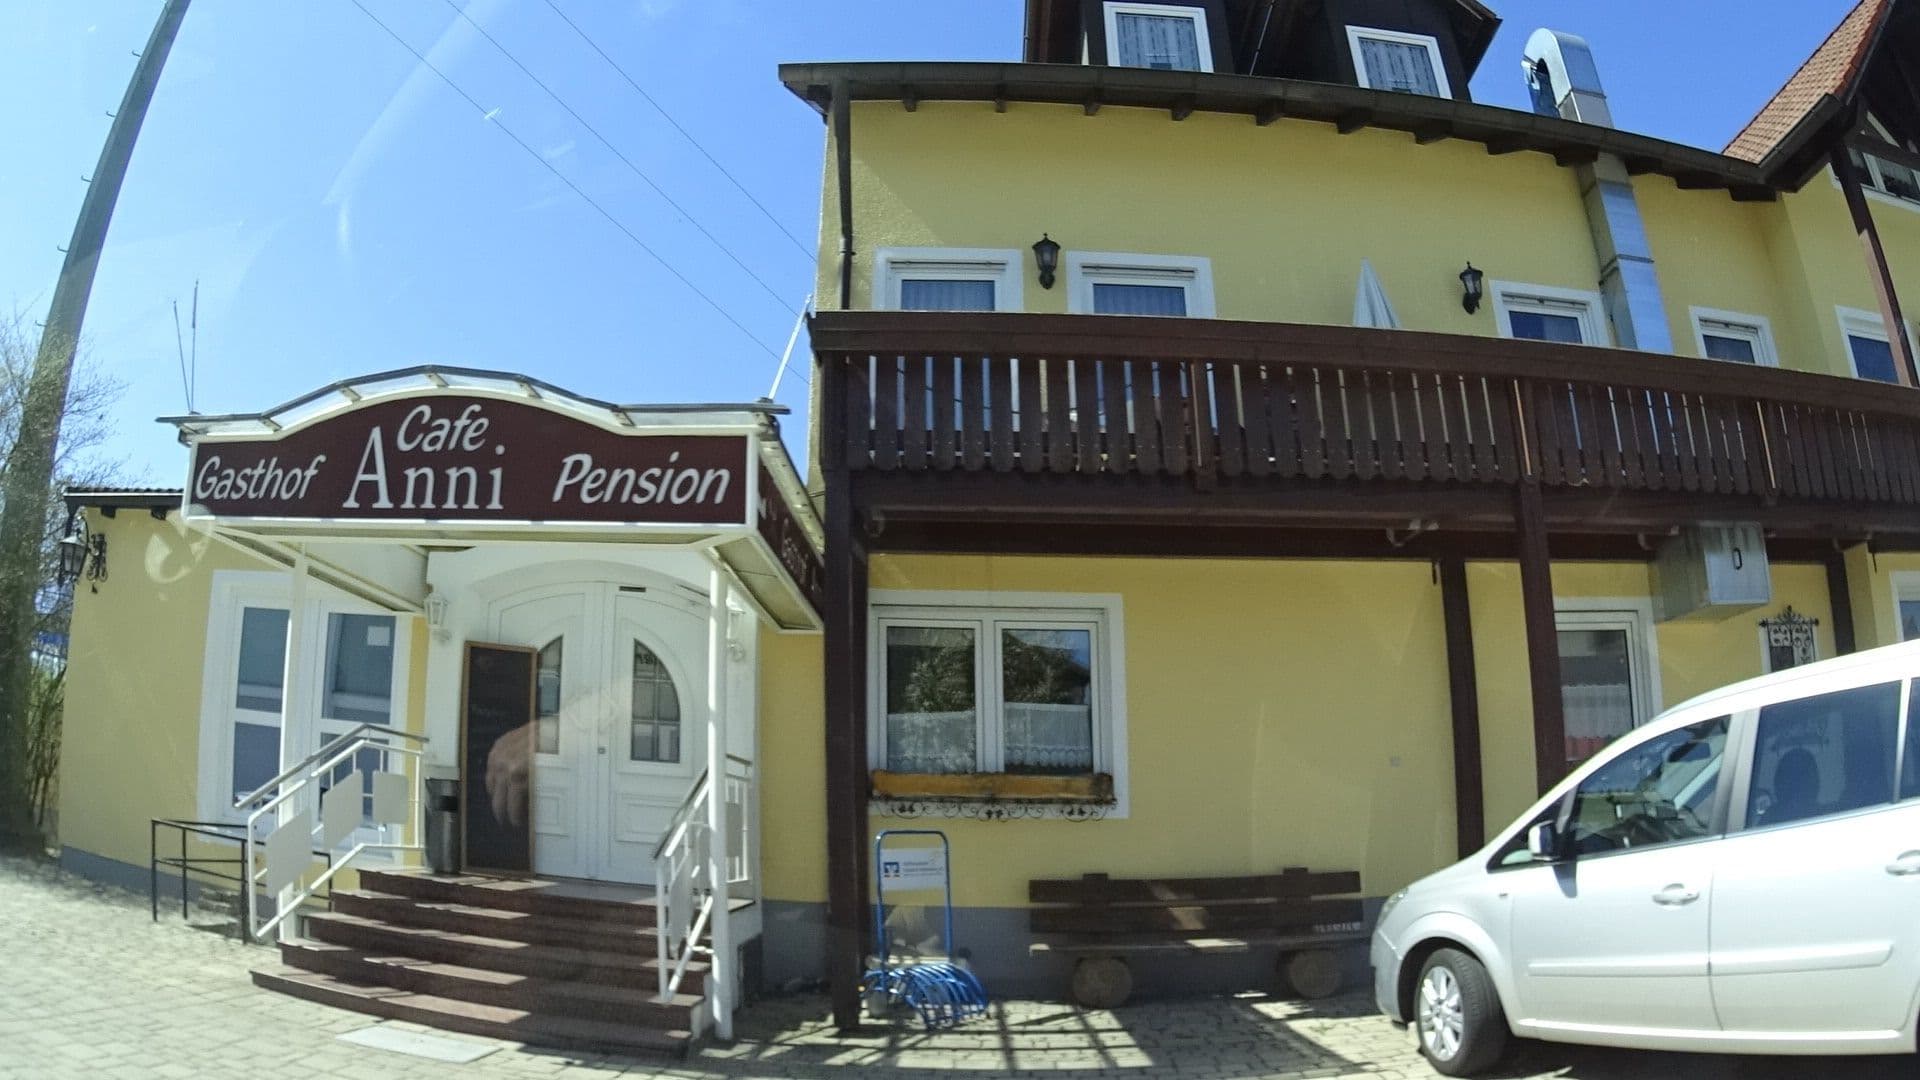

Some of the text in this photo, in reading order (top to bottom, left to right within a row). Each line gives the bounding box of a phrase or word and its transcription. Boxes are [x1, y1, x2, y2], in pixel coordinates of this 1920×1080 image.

[397, 404, 489, 452] Cafe
[195, 455, 327, 500] Gasthof
[342, 426, 505, 509] Anni
[552, 451, 730, 504] Pension
